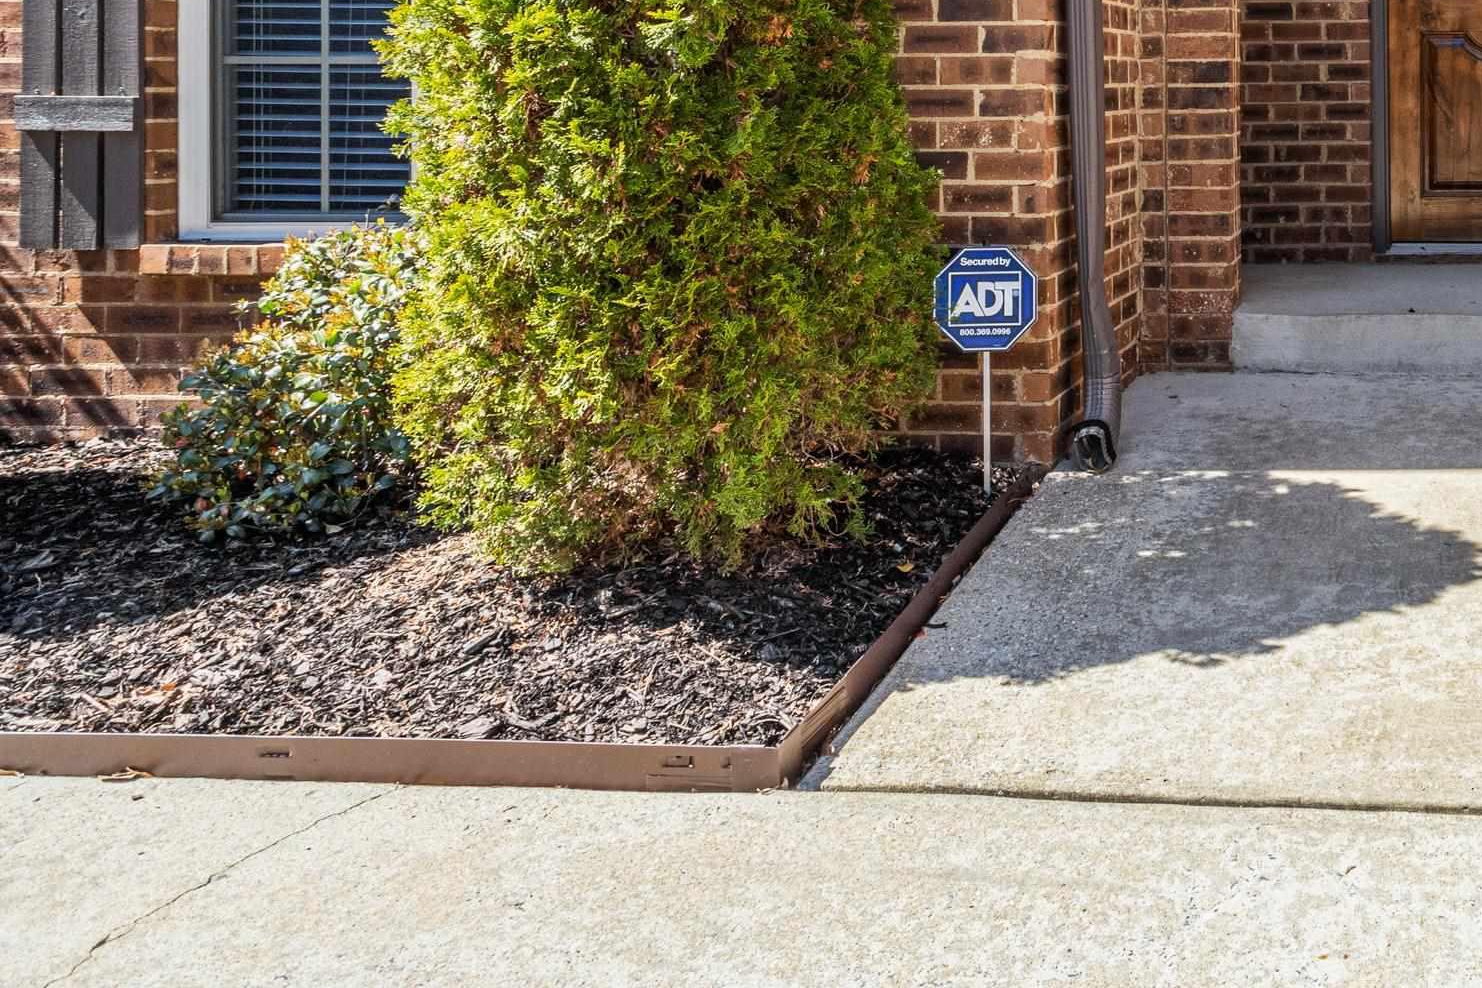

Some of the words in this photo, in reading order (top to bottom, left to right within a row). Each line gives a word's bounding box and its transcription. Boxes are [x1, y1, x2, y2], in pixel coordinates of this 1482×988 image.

[960, 257, 999, 266] Secured
[999, 257, 1012, 267] by
[950, 281, 1020, 317] ADT
